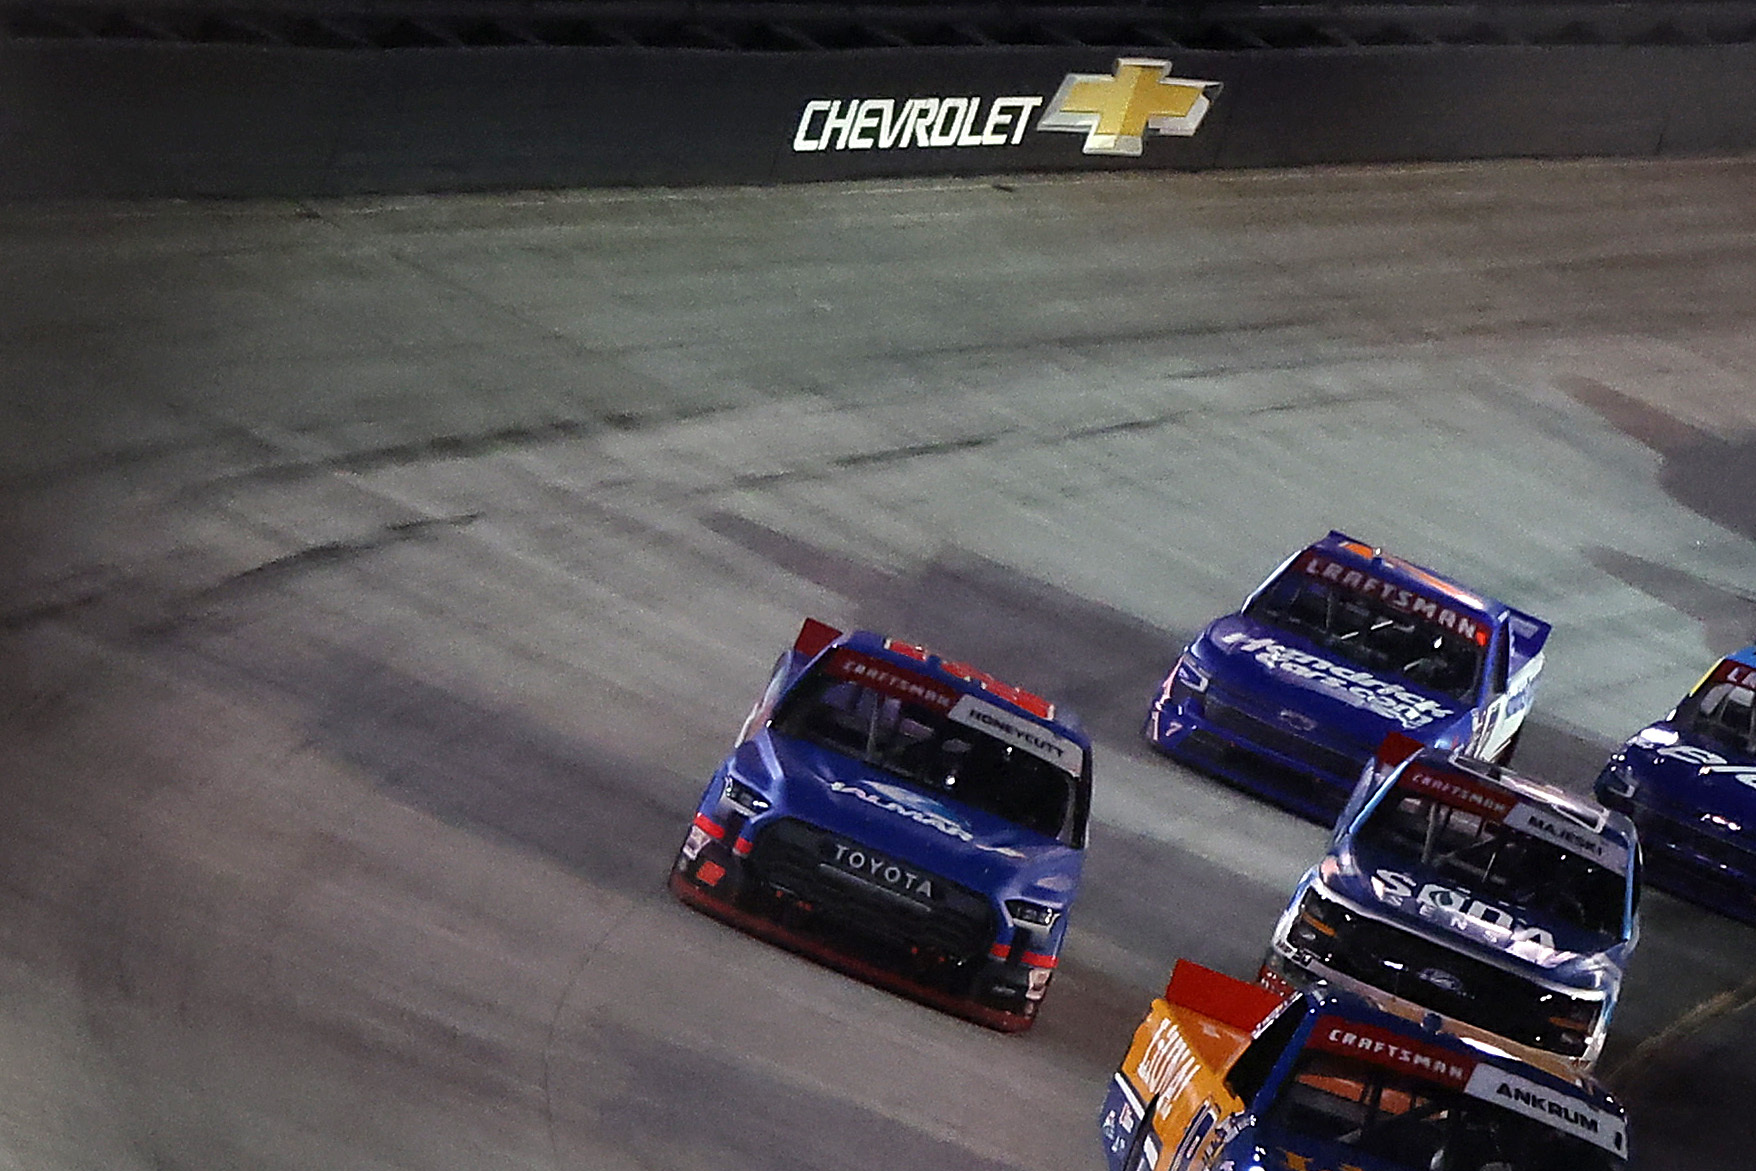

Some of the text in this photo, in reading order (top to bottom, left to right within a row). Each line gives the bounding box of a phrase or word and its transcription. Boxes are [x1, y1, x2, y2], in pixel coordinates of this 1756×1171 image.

[792, 95, 1043, 153] CHEVROLET
[1305, 557, 1478, 640] CRAFTSMAN
[842, 660, 951, 707] CRAFTSMAN
[968, 708, 1066, 758] HONEYCUTT
[1411, 772, 1506, 813] CRAFTSMAN
[1527, 814, 1604, 857] MAJESKI
[836, 844, 933, 898] TOYOTA
[1327, 1028, 1465, 1081] CRAFTSMAN
[1495, 1080, 1599, 1134] ANKRUM
